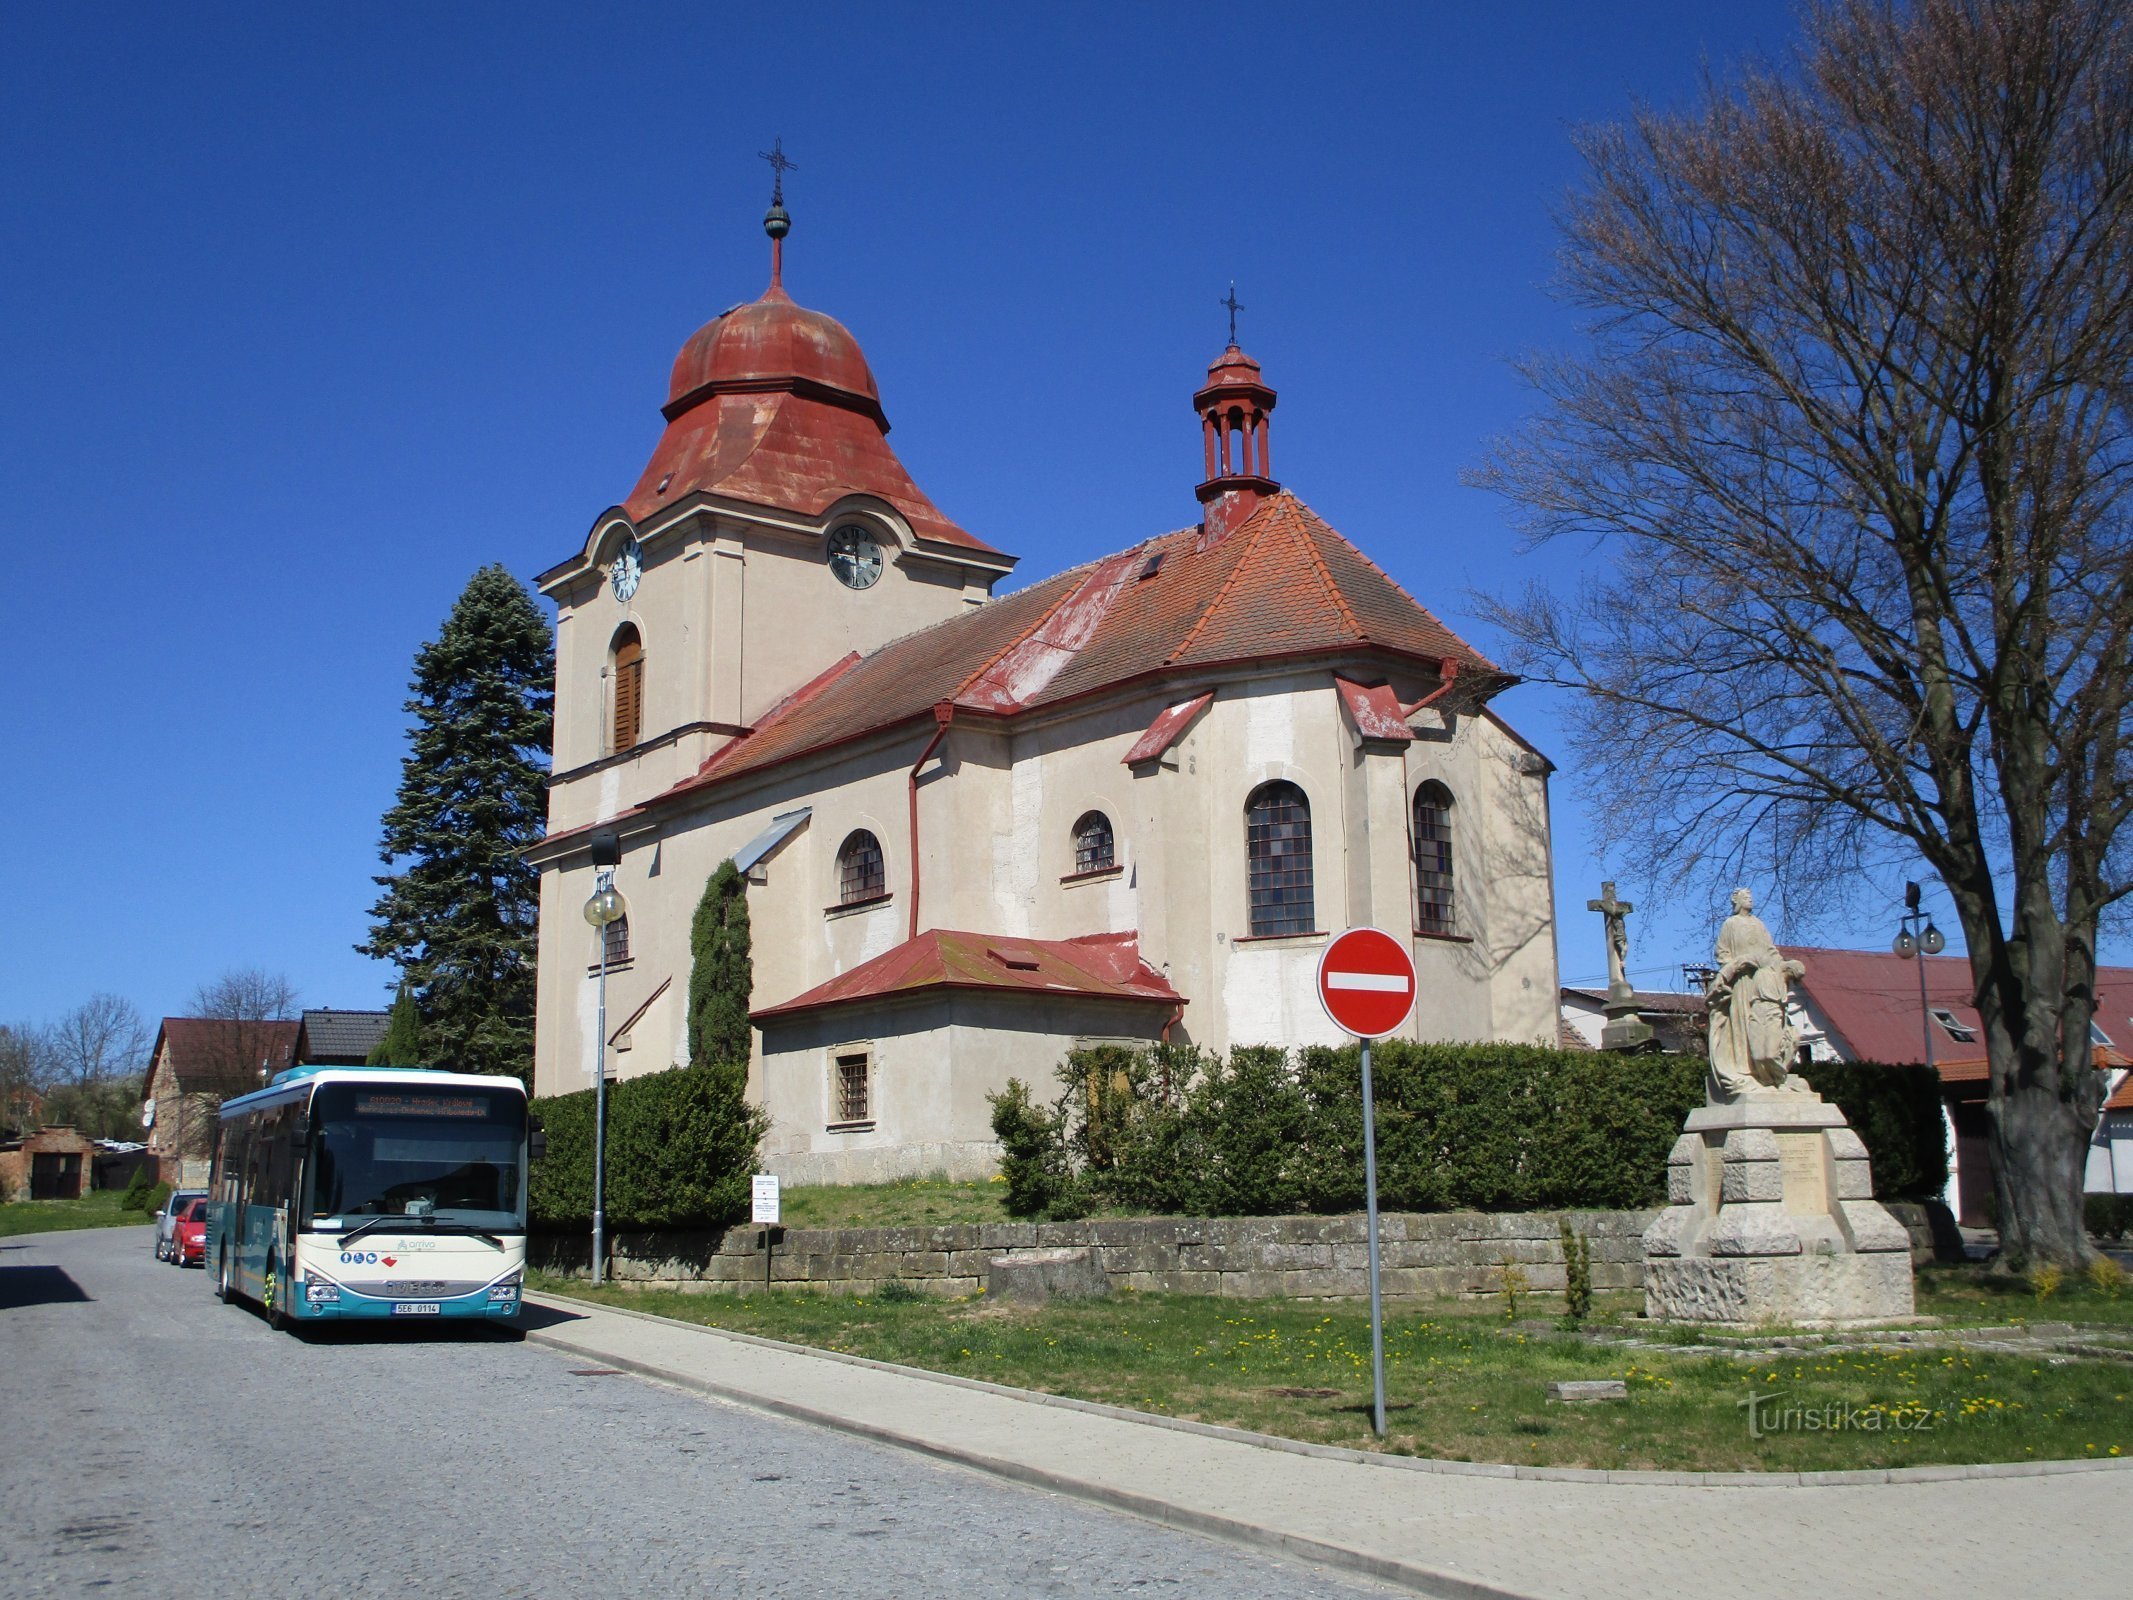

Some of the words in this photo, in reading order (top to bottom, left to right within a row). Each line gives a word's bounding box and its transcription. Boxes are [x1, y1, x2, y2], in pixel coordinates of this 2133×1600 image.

[408, 1240, 436, 1248] arriva
[386, 1281, 446, 1294] IVECO
[398, 1304, 412, 1313] 5E6
[417, 1304, 437, 1313] 0114
